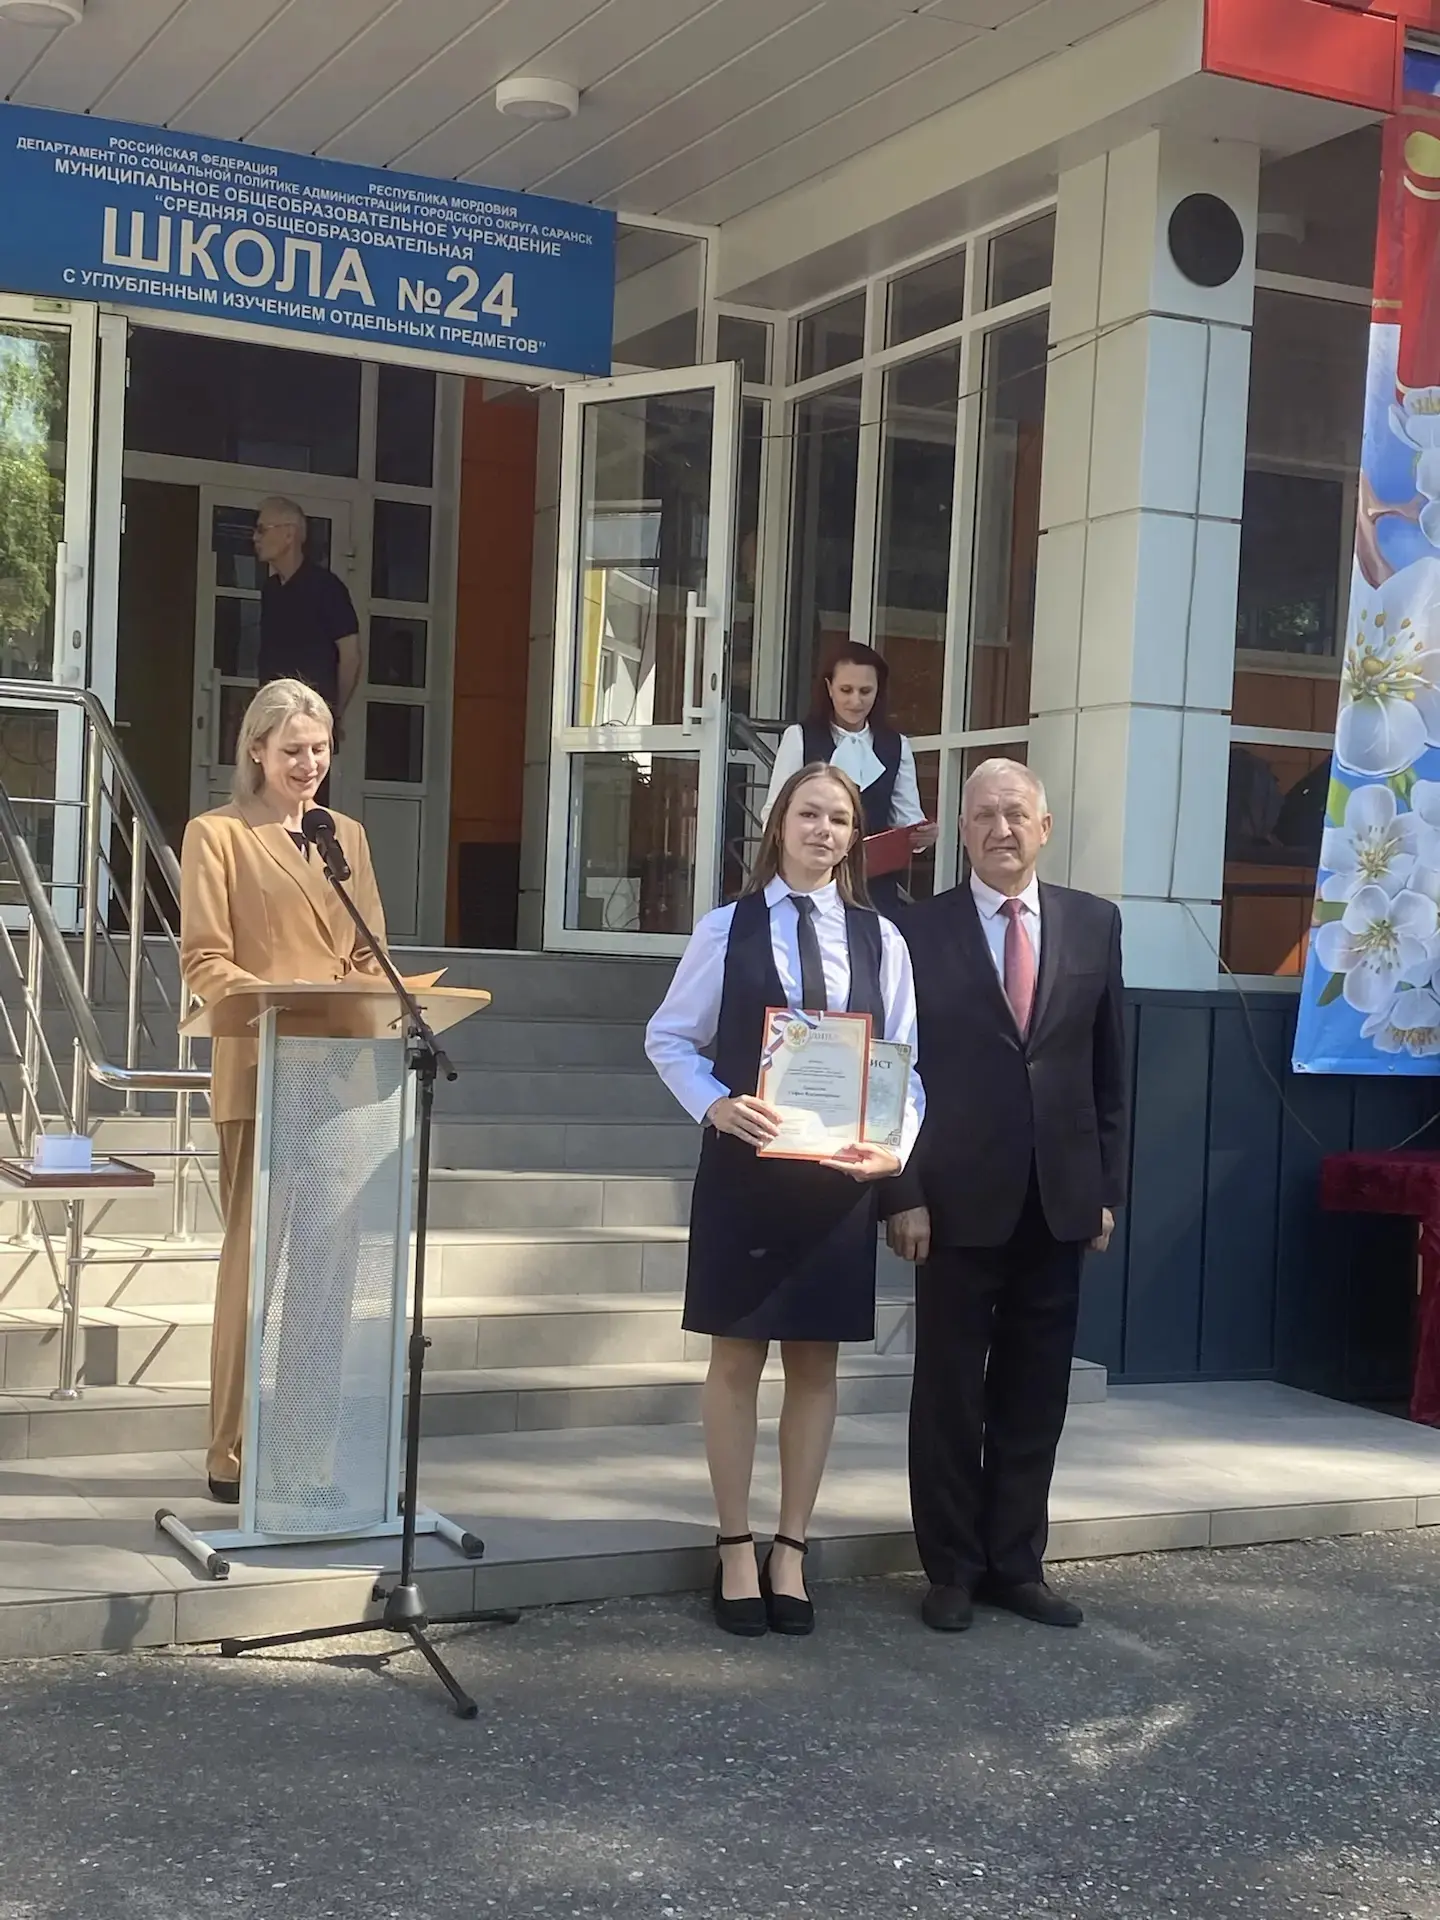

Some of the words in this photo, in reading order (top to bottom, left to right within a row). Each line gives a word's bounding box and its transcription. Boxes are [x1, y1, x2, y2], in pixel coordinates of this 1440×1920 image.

[110, 137, 197, 162] РОССИЙСКАЯ
[201, 154, 277, 176] ФЕДЕРАЦИЯ
[17, 137, 116, 162] ДЕПАРТАМЕНТ
[119, 153, 138, 165] ПО
[141, 157, 231, 182] СОЦИАЛЬНОЙ
[235, 173, 299, 194] ПОЛИТИКЕ
[302, 186, 410, 213] АДМИНИСТРАЦИИ
[414, 205, 493, 226] ГОРОДСКОГО
[496, 219, 538, 235] ОКРУГА
[542, 227, 592, 244] САРАНСК
[55, 158, 219, 198] МУНИЦИПАЛЬНОЕ
[225, 187, 447, 237] ОБЩЕОБРАЗОВАТЕЛЬНОЕ
[452, 226, 560, 256] УЧРЕЖДЕНИЕ
[369, 184, 448, 206] РЕСПУБЛИКА
[451, 197, 517, 217] МОРДОВИЯ
[103, 207, 376, 306] ШКОЛА
[253, 212, 473, 261] ОБЩЕОБРАЗОВАТЕЛЬНАЯ
[63, 269, 75, 283] С
[81, 270, 217, 304] УГЛУБЛЕННЫМ
[223, 292, 325, 321] ИЗУЧЕНИЕМ
[330, 310, 435, 338] ОТДЕЛЬНЫХ
[870, 1058, 893, 1069] ИСТ
